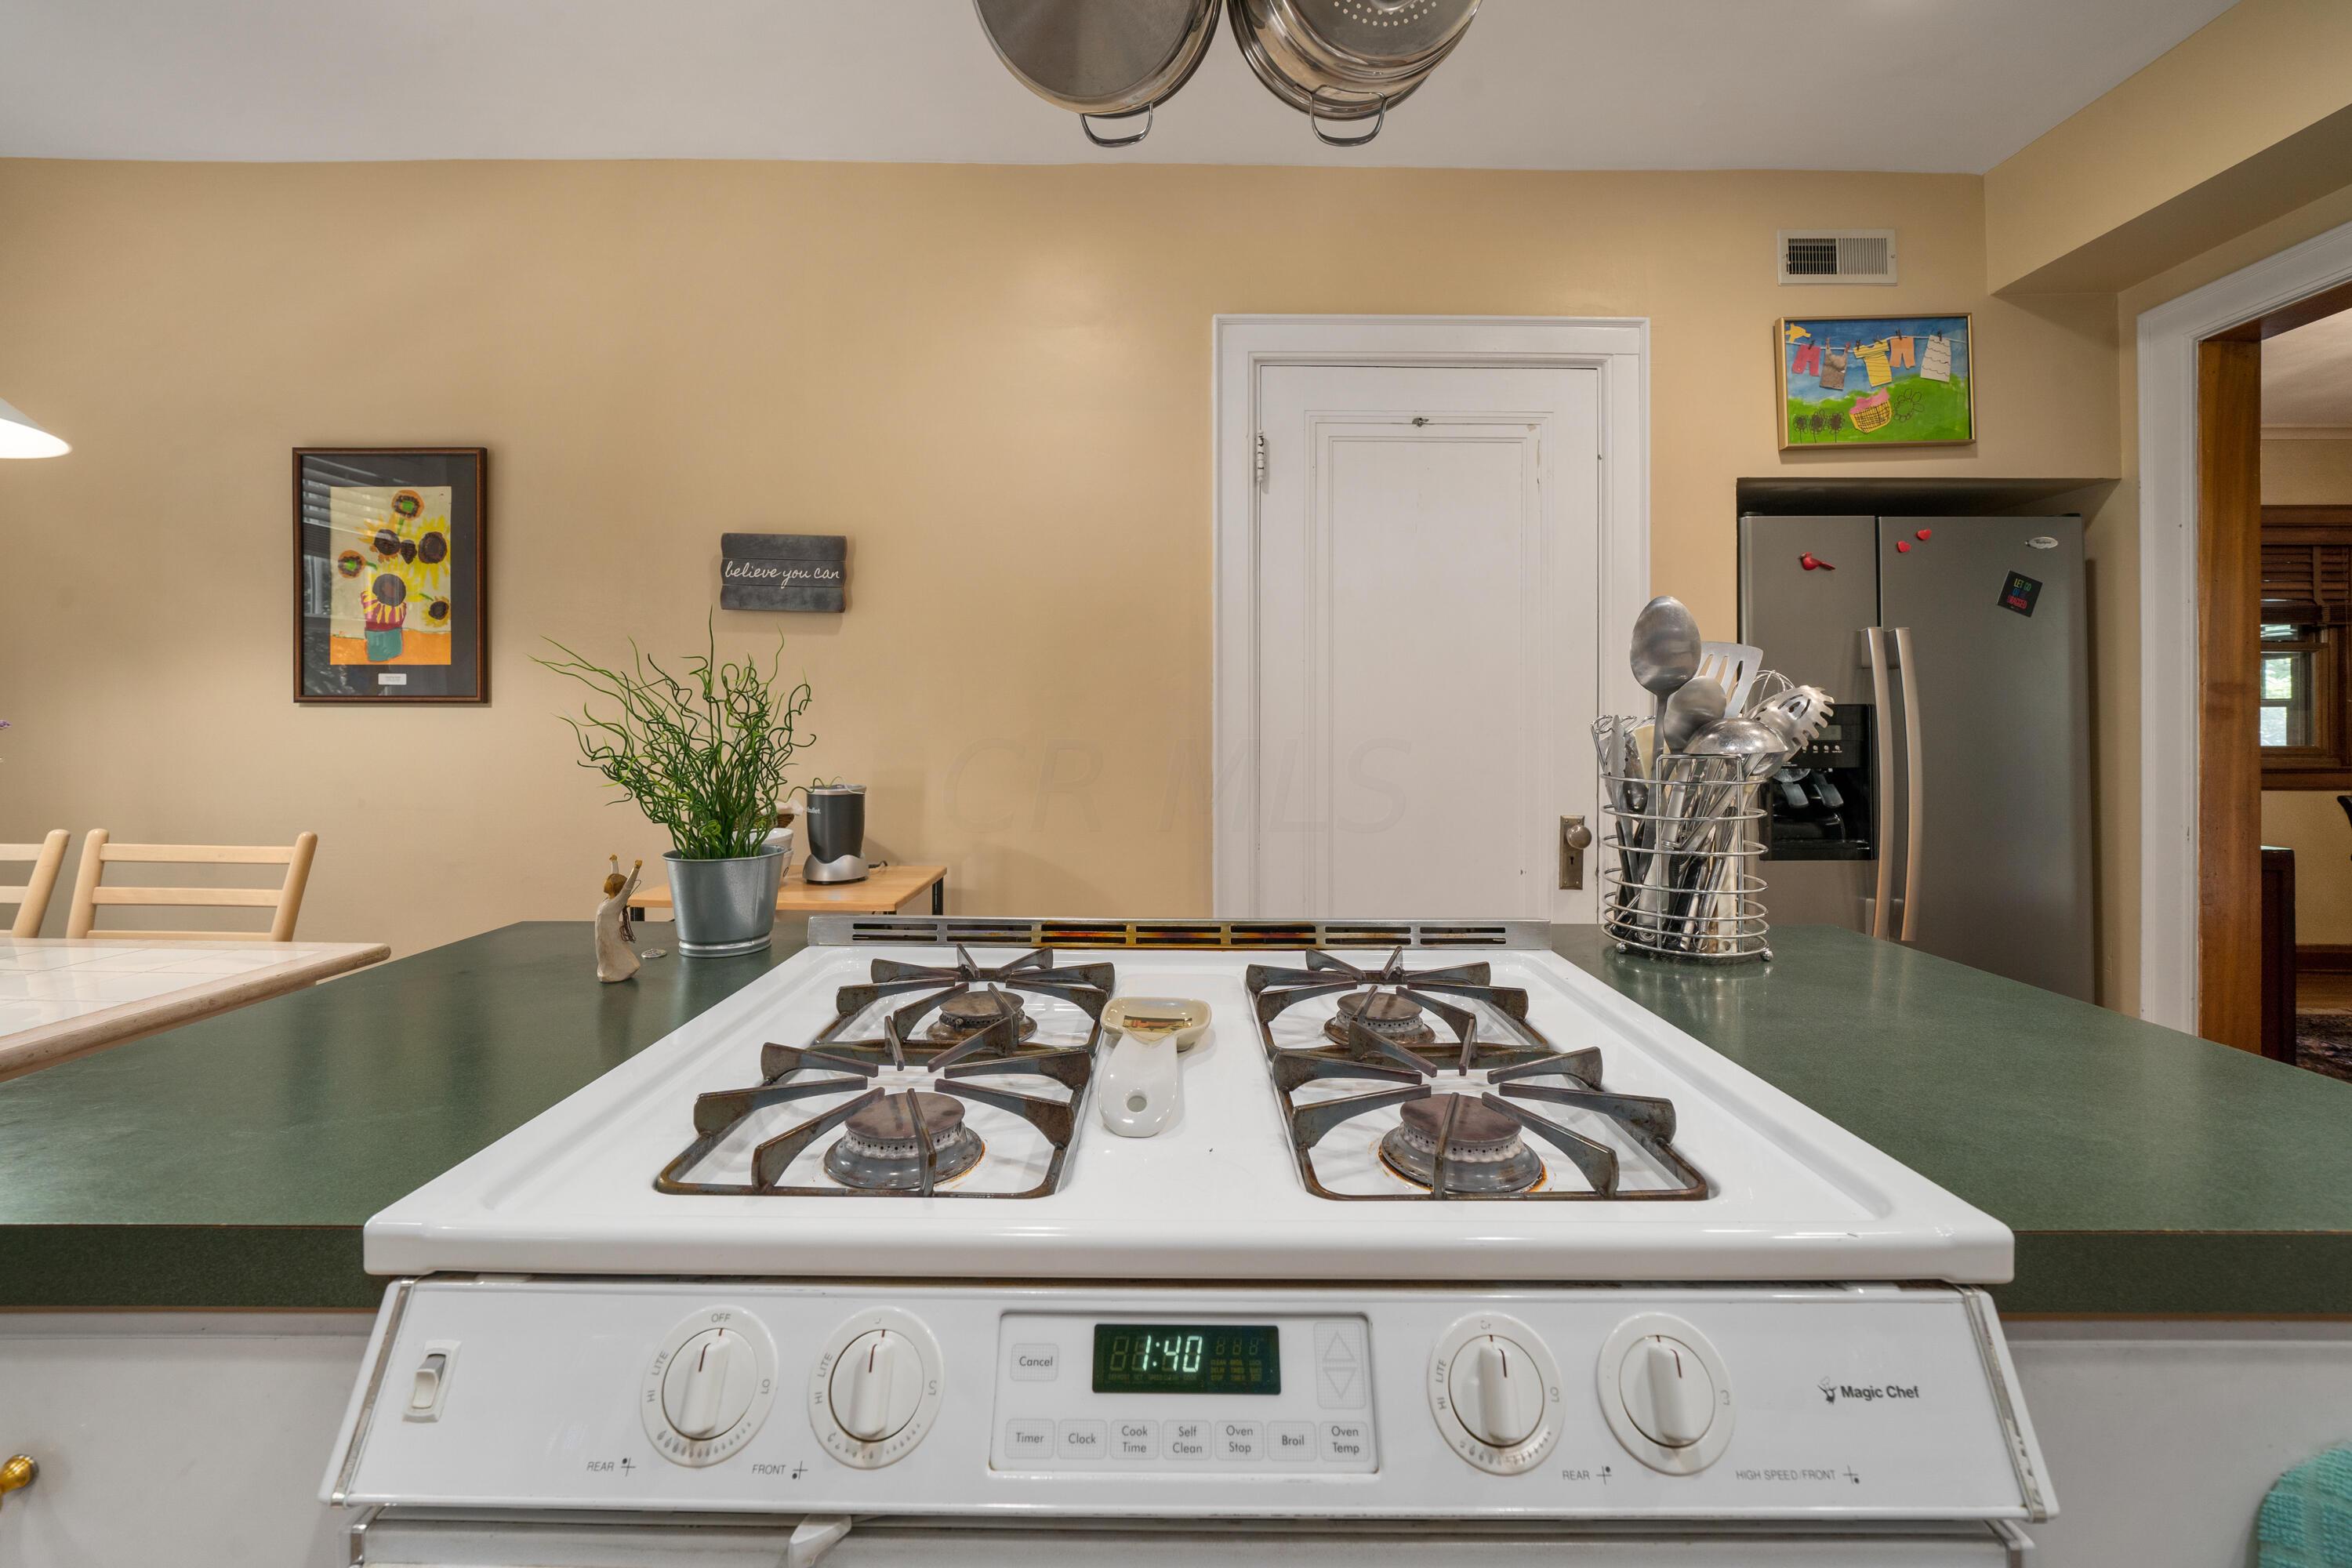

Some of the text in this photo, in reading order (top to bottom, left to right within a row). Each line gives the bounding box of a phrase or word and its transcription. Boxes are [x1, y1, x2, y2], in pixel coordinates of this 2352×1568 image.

[725, 561, 840, 589] believe you can
[711, 1313, 731, 1323] OFF
[1142, 1335, 1203, 1372] 1:40
[652, 1350, 669, 1376] LITE
[817, 1352, 833, 1377] LITE
[1019, 1356, 1053, 1368] Cancel
[1436, 1359, 1447, 1383] LITE
[760, 1378, 771, 1395] LO
[647, 1390, 655, 1403] HI
[815, 1392, 822, 1404] HI
[1550, 1386, 1560, 1403] LO
[1840, 1385, 1920, 1402] Magic Chef
[1436, 1397, 1447, 1410] HI
[1122, 1425, 1148, 1437] Cook
[1178, 1425, 1196, 1437] Self
[1225, 1426, 1254, 1437] Oven
[1331, 1426, 1359, 1437] Oven
[1016, 1432, 1044, 1443] Timer
[1069, 1433, 1095, 1445] Clock
[1282, 1436, 1305, 1446] Broil
[1123, 1442, 1146, 1453] Time
[1173, 1442, 1203, 1454] Clean
[1229, 1442, 1251, 1455] Stop
[1333, 1443, 1359, 1455] Temp
[586, 1461, 615, 1472] REAR
[752, 1464, 786, 1475] FRONT
[1562, 1469, 1591, 1481] REAR
[1735, 1469, 1762, 1480] HIGH
